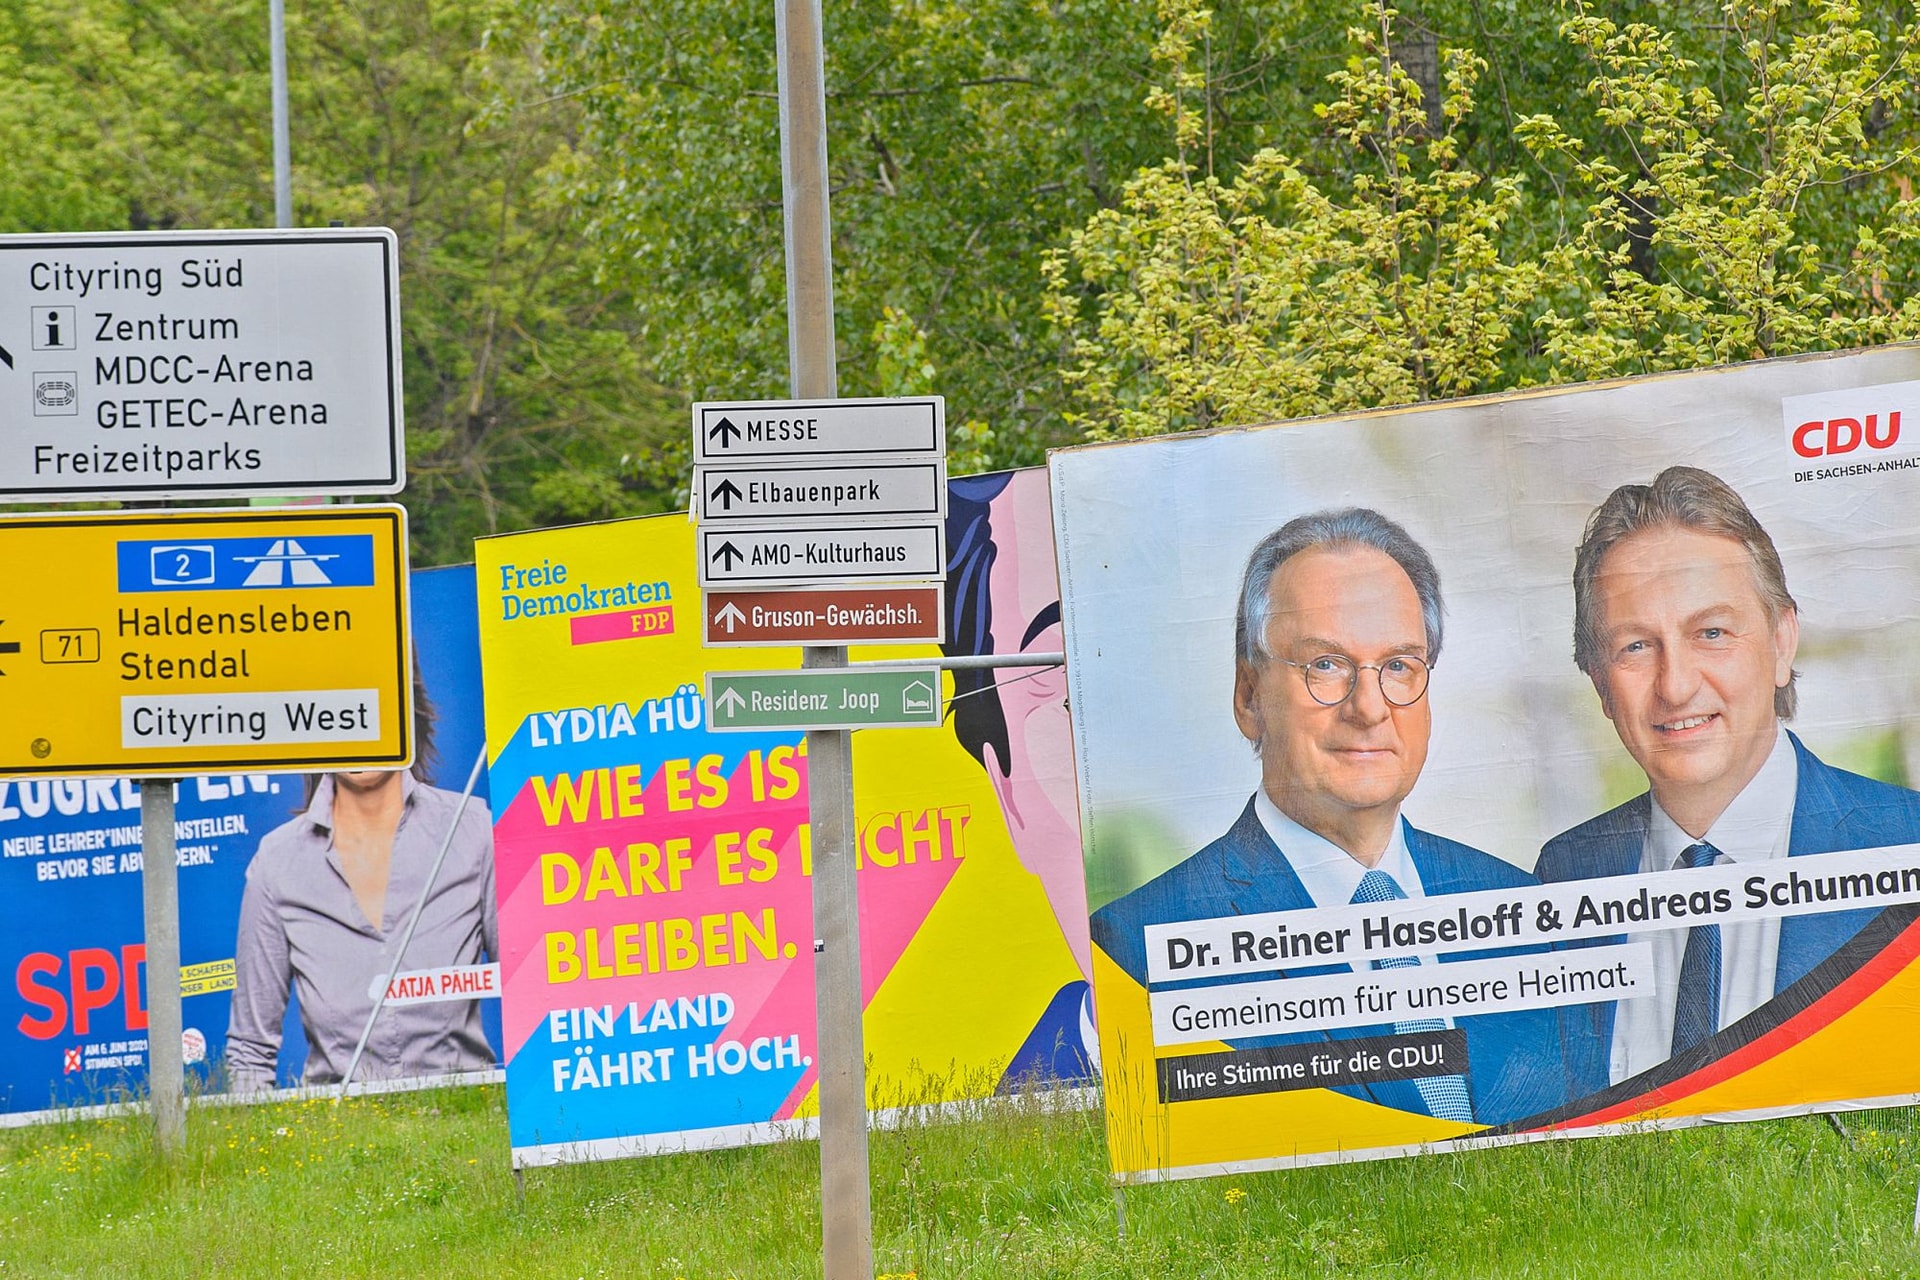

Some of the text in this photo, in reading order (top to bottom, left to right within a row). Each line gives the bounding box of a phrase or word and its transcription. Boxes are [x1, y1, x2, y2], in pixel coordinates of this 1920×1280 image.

[30, 258, 243, 297] Cityring Süd
[94, 312, 240, 341] Zentrum
[95, 354, 314, 385] MDCC-Arena
[97, 398, 329, 429] GETEC-Arena
[747, 419, 818, 441] MESSE
[1792, 411, 1901, 458] CDU
[34, 442, 262, 479] Freizeitparks
[1793, 470, 1814, 483] DIE
[749, 479, 881, 506] Elbauenpark
[176, 554, 191, 577] 2
[751, 542, 906, 565] AMO-Kulturhaus
[500, 559, 567, 591] Freie
[502, 580, 672, 621] Demokraten
[751, 603, 922, 628] Gruson-Gewächsh.
[118, 603, 352, 637] Haldensleben
[631, 611, 670, 633] FDP
[58, 635, 83, 657] 71
[121, 649, 249, 680] Stendal
[751, 689, 880, 714] Residenz Joop
[133, 702, 368, 742] Cityring West
[530, 703, 637, 748] LYDIA
[530, 764, 644, 827] WIE
[664, 754, 729, 812] ES
[3, 814, 249, 858] NEUE LEHRERINNE NSTELLEN,
[37, 858, 88, 881] BEVOR
[92, 855, 116, 876] SIE
[540, 804, 970, 906] DARF ES CHT
[1167, 938, 1220, 970] Dr.
[1232, 925, 1350, 964] Reiner
[1363, 902, 1523, 950] Haseloff
[1536, 899, 1563, 932] &
[1573, 888, 1731, 928] Andreas
[544, 908, 798, 985] BLEIBEN.
[441, 969, 493, 994] PÄHLE
[1172, 962, 1636, 1032] Gemeinsam für unsere Heimat.
[550, 992, 735, 1043] EIN LAND
[552, 1034, 813, 1092] FÄHRT HOCH.
[1176, 1044, 1444, 1090] Ihre Stimme für die CDU!
